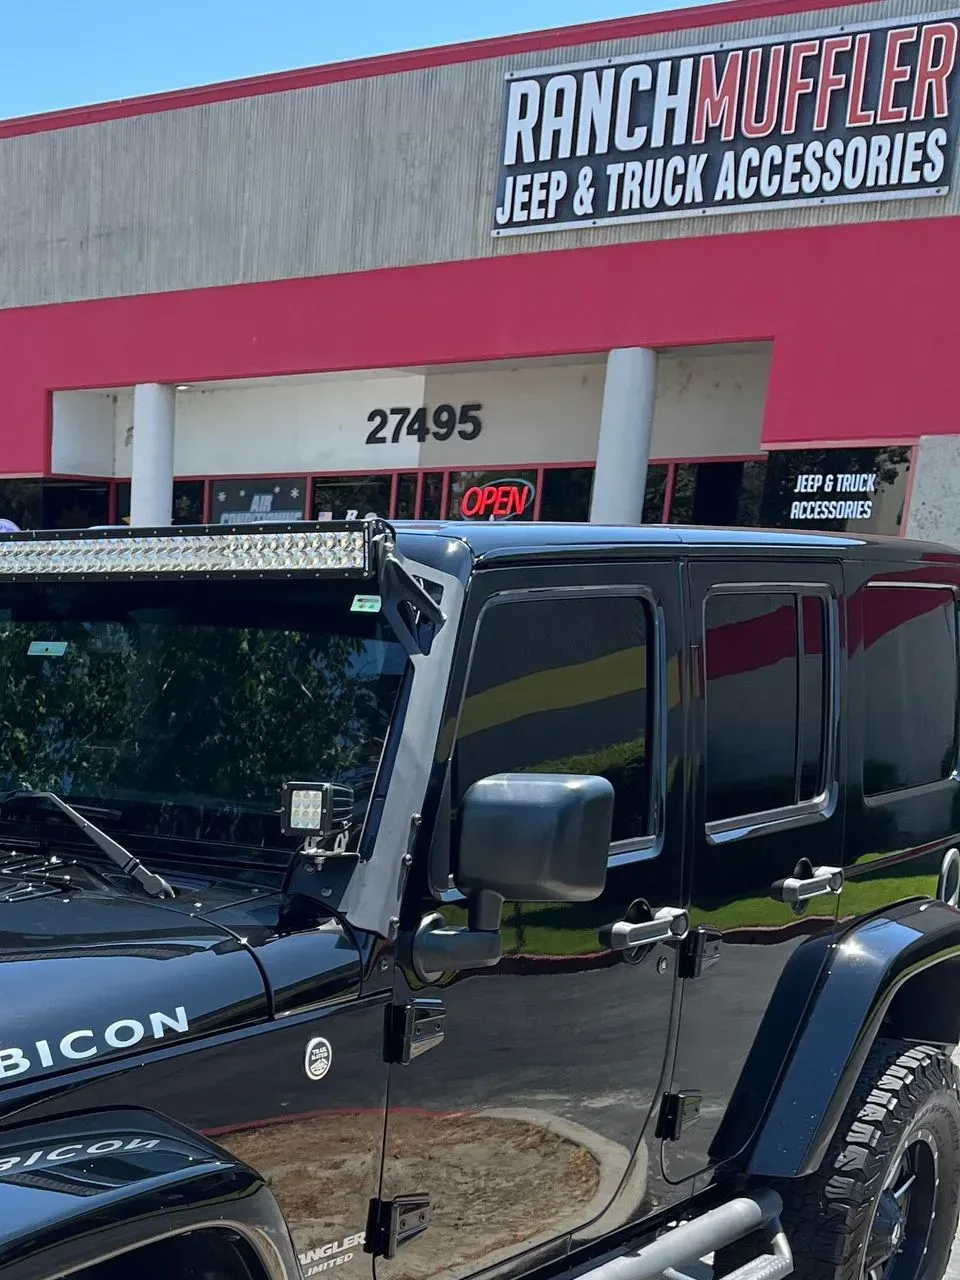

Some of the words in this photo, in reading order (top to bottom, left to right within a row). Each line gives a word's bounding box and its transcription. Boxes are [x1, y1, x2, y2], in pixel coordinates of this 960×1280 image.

[496, 170, 567, 225] JEEP
[573, 166, 594, 215] &
[607, 153, 708, 212] TRUCK
[714, 128, 947, 200] ACCESSORIES
[365, 403, 483, 444] 27495
[794, 474, 822, 492] JEEP
[824, 474, 833, 492] &
[837, 473, 876, 492] TRUCK
[250, 494, 273, 512] AIR
[461, 485, 529, 517] OPEN
[790, 501, 872, 519] ACCESSORIES
